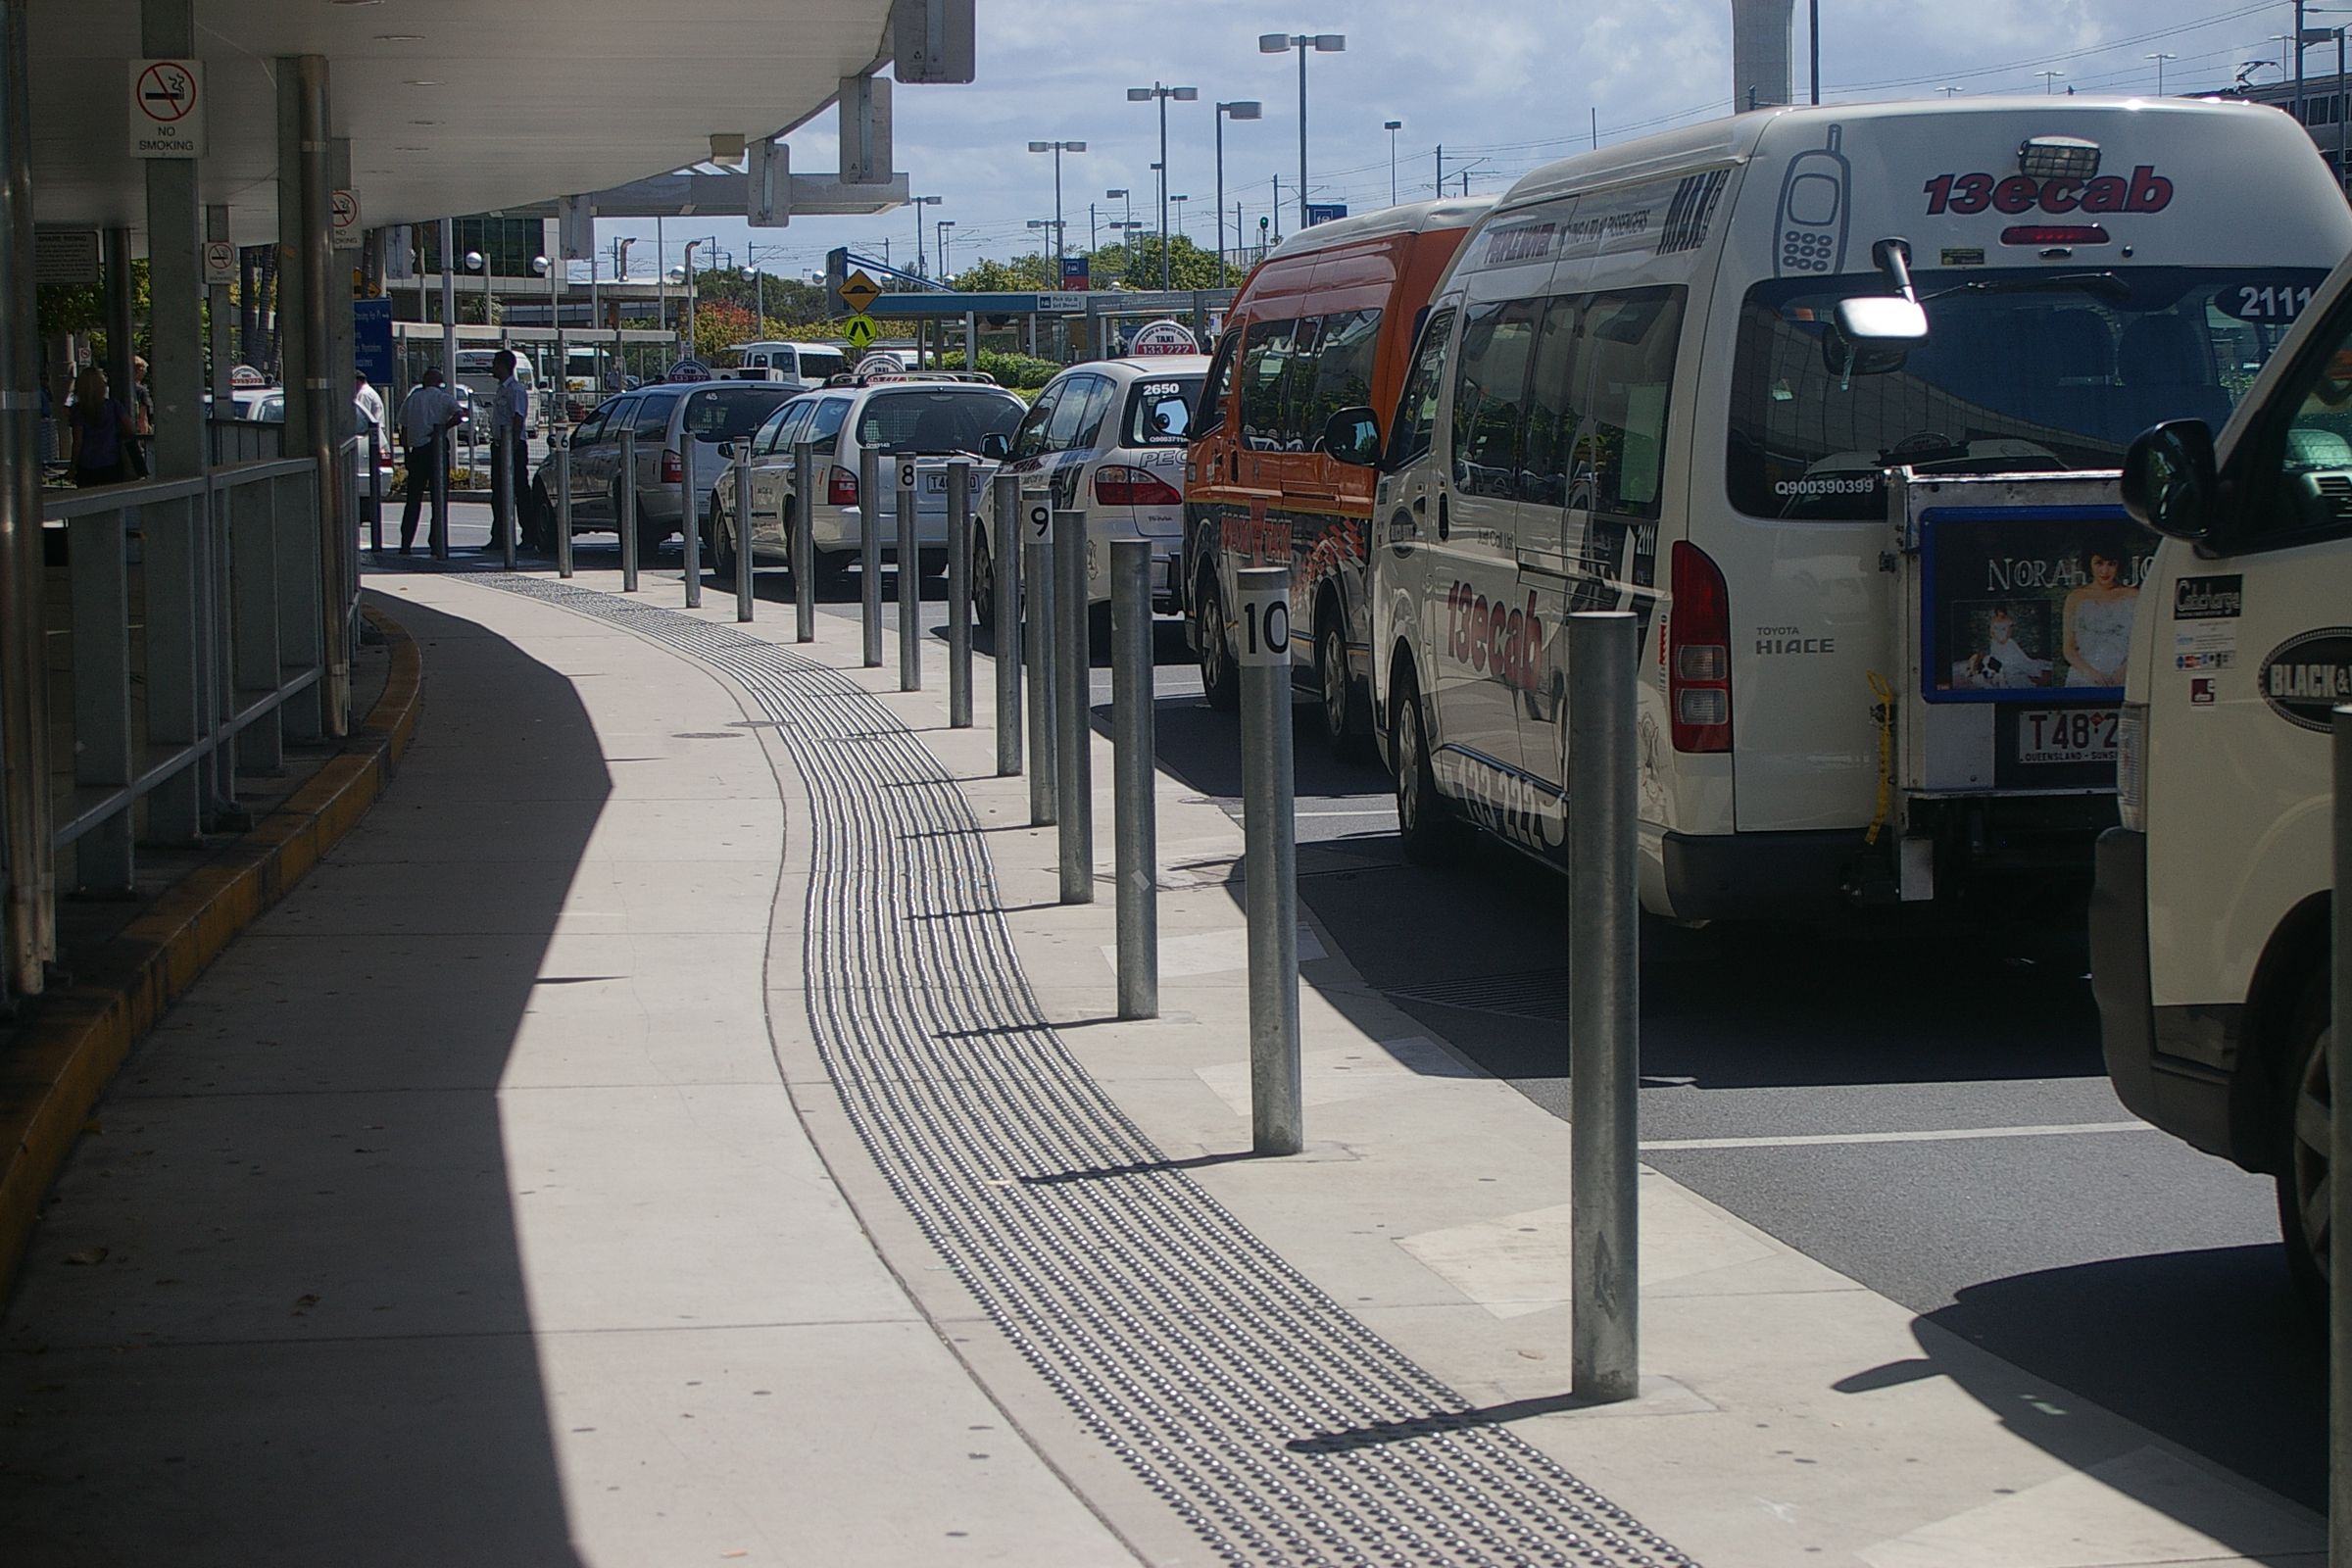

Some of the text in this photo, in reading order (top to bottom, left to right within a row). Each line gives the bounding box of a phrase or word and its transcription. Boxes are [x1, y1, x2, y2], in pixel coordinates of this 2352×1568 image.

[158, 126, 175, 136] NO
[138, 141, 194, 151] SMOKING
[1923, 165, 2172, 215] 13ecab
[2238, 286, 2311, 317] 2111
[1143, 345, 1190, 355] 133 222
[1143, 383, 1180, 396] 2650
[561, 434, 568, 448] 6
[739, 446, 750, 464] 7
[902, 465, 914, 486] 8
[1775, 480, 1875, 495] Q900390399
[1031, 507, 1049, 536] 9
[1490, 530, 1504, 549] Call
[1636, 524, 1656, 557] 2111
[1244, 601, 1289, 655] 10
[1447, 580, 1542, 692] 13ecab
[1756, 626, 1799, 635] TOYOTA
[1755, 638, 1836, 655] HIACE
[2025, 752, 2082, 761] QUEENSLAND
[1458, 755, 1498, 832] 133
